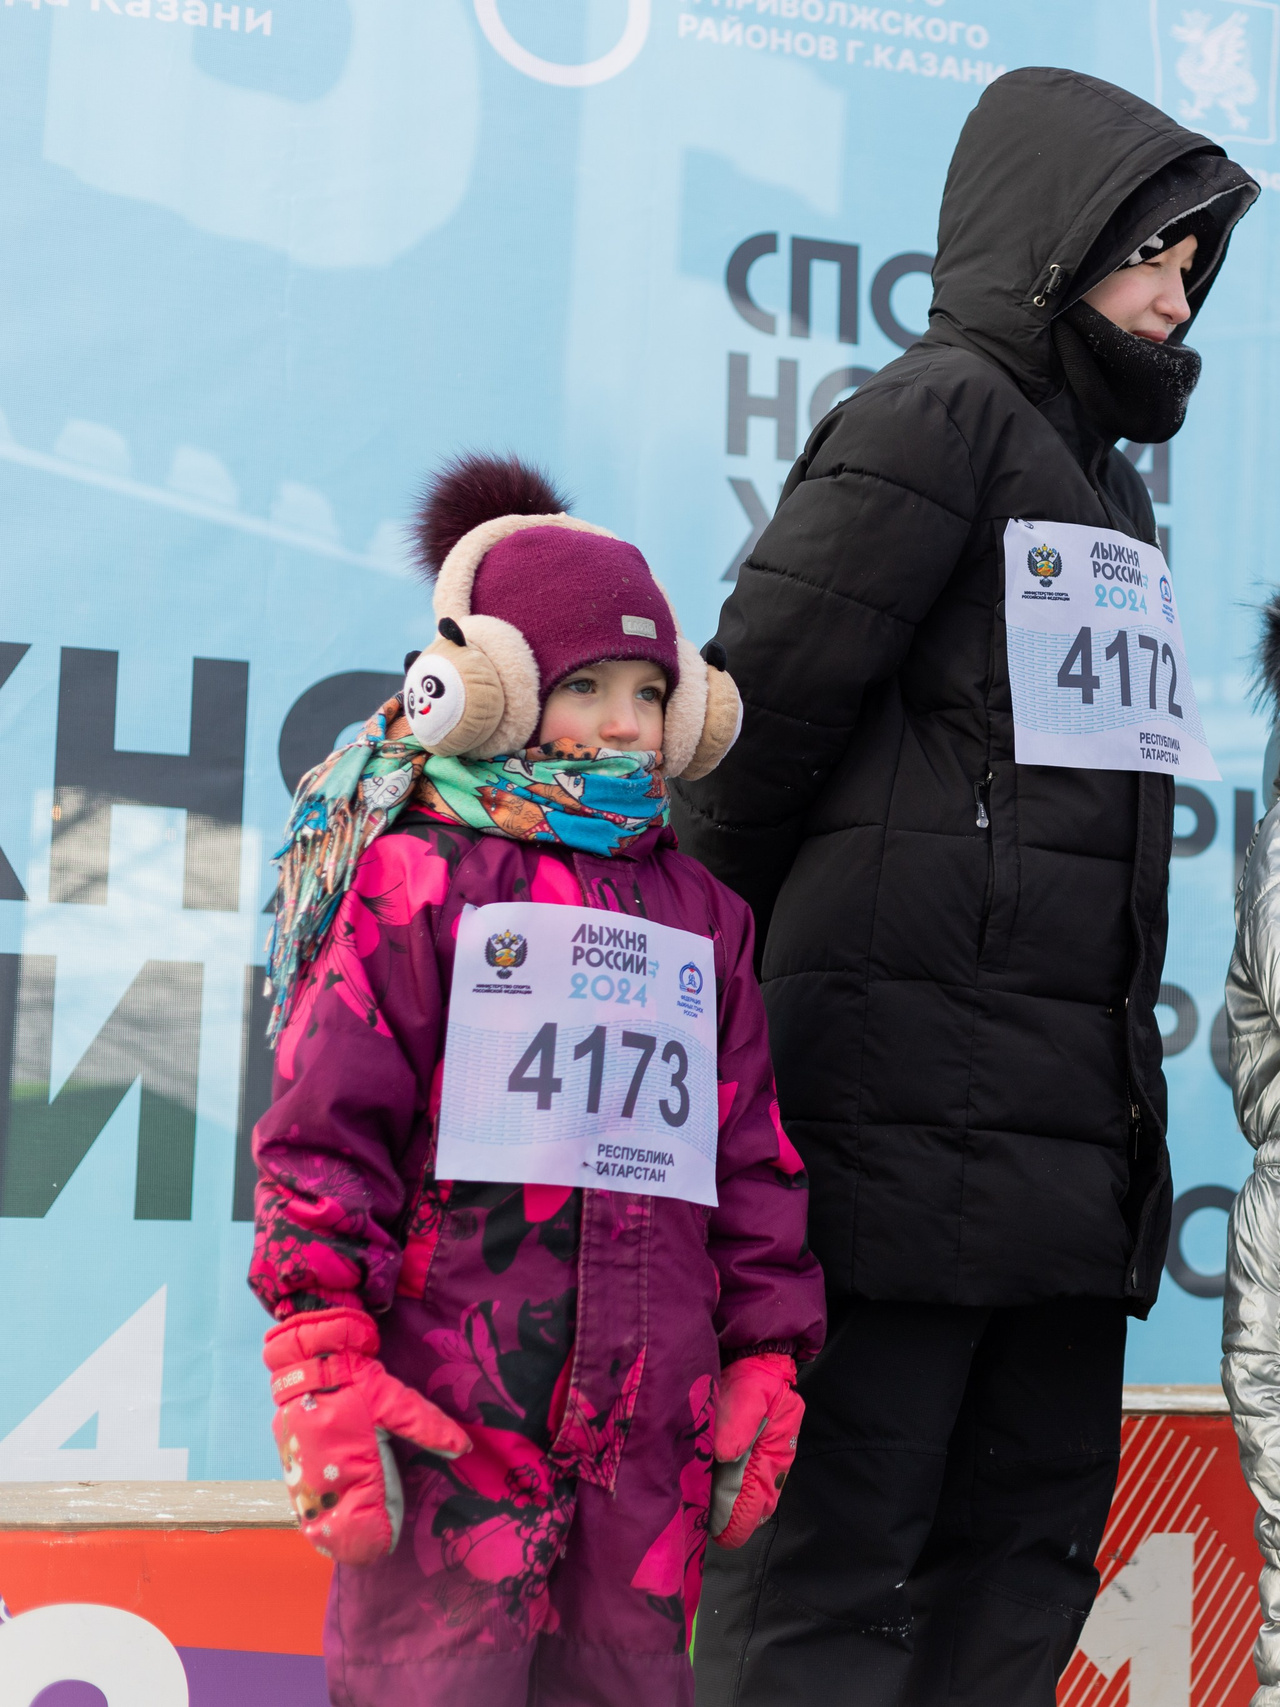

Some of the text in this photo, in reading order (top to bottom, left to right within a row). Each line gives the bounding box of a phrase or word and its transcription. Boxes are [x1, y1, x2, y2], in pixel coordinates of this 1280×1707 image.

[678, 13, 839, 61] РАЙОНОВ
[726, 231, 935, 350] СПО
[1090, 541, 1140, 568] ЛЫЖНЯ
[1092, 560, 1143, 587] РОССИИ
[1094, 583, 1147, 615] 2024
[1057, 626, 1184, 719] 4172
[1139, 732, 1181, 752] РЕСПУБЛИКА
[1139, 747, 1180, 765] ТАТАРСТАН
[571, 923, 647, 954] ЛЫЖНЯ
[572, 945, 647, 976] РОССИИ
[568, 972, 648, 1008] 2024
[507, 1022, 690, 1128] 4173
[597, 1143, 675, 1167] РЕСПУБЛИКА
[595, 1160, 666, 1183] ТАТАРСТАН
[282, 1369, 305, 1388] DEER
